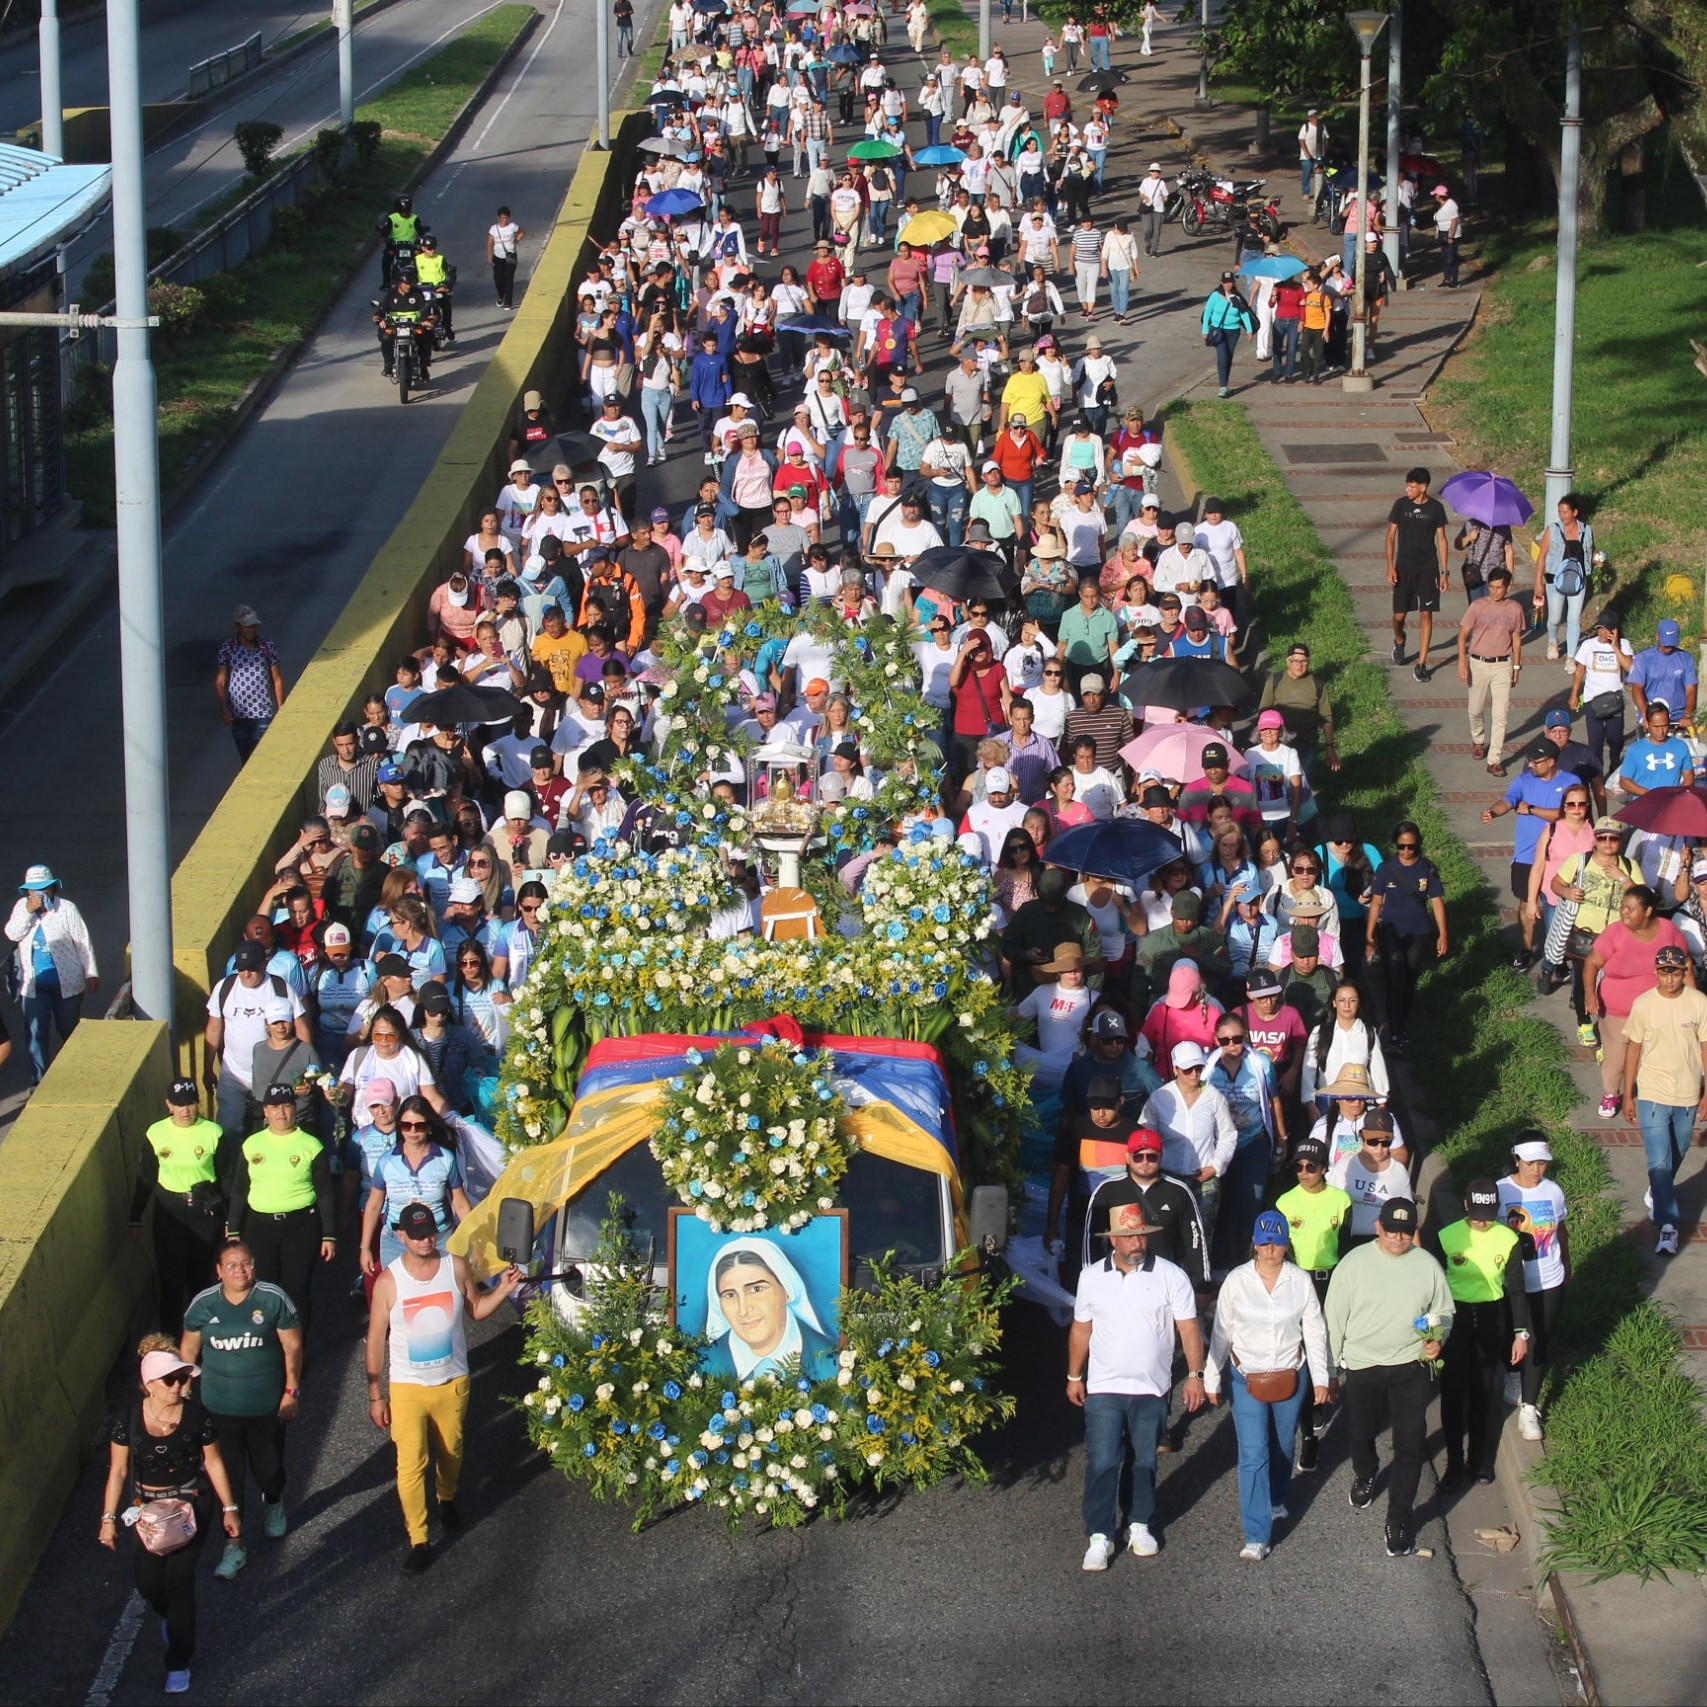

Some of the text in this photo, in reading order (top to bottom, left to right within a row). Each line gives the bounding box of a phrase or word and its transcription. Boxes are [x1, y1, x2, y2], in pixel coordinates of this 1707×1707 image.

[1249, 1030, 1286, 1044] NASA
[174, 1082, 195, 1093] 9-1-1
[270, 1086, 291, 1096] 9-1-1
[1355, 1180, 1389, 1194] USA
[210, 1332, 263, 1350] bwin
